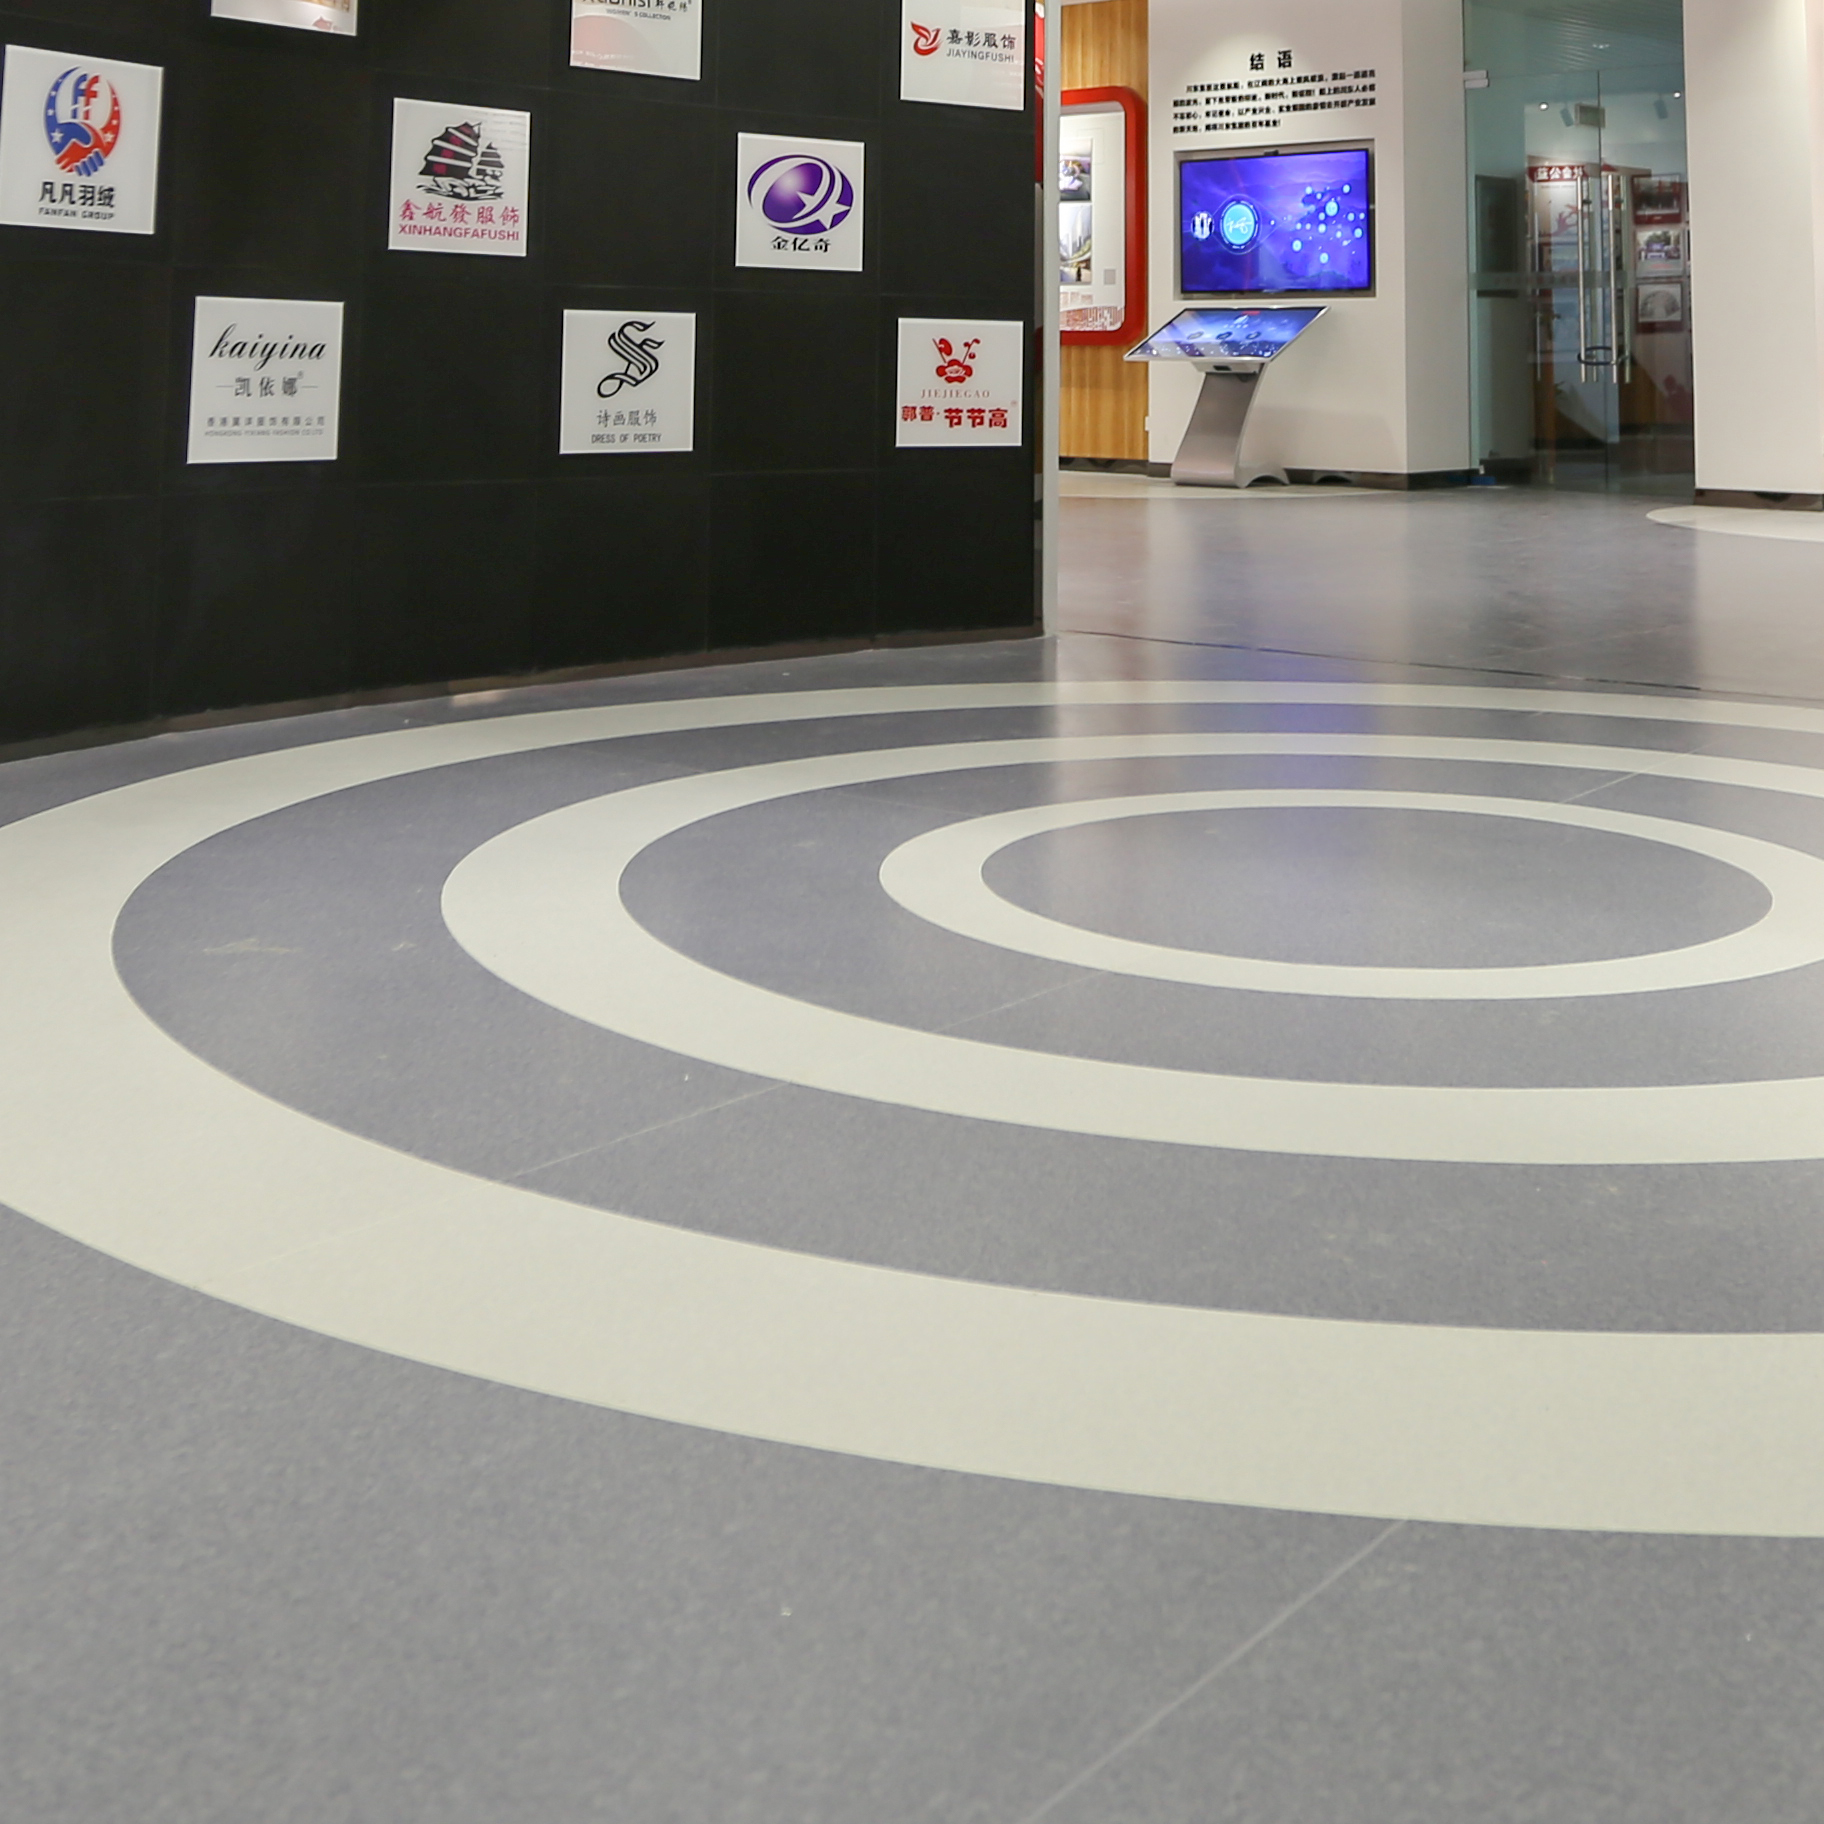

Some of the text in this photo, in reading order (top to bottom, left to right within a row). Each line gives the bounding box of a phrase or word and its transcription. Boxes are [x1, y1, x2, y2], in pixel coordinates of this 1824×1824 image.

[947, 29, 1016, 50] 嘉影服饰
[946, 47, 1015, 63] JIAYINGFUSHI
[1249, 50, 1293, 71] 结语
[39, 181, 115, 208] 凡凡羽绒
[38, 207, 115, 220] FANFAN GROUP
[398, 224, 520, 242] XINHANGFAFUSHI
[771, 236, 831, 254] 金亿奇
[208, 324, 326, 370] kaiyina
[233, 377, 299, 399] 凯依娜
[921, 388, 991, 399] JIEJIEGAO
[596, 409, 657, 428] 诗画服饰
[591, 432, 662, 444] DRESS OF POETRY
